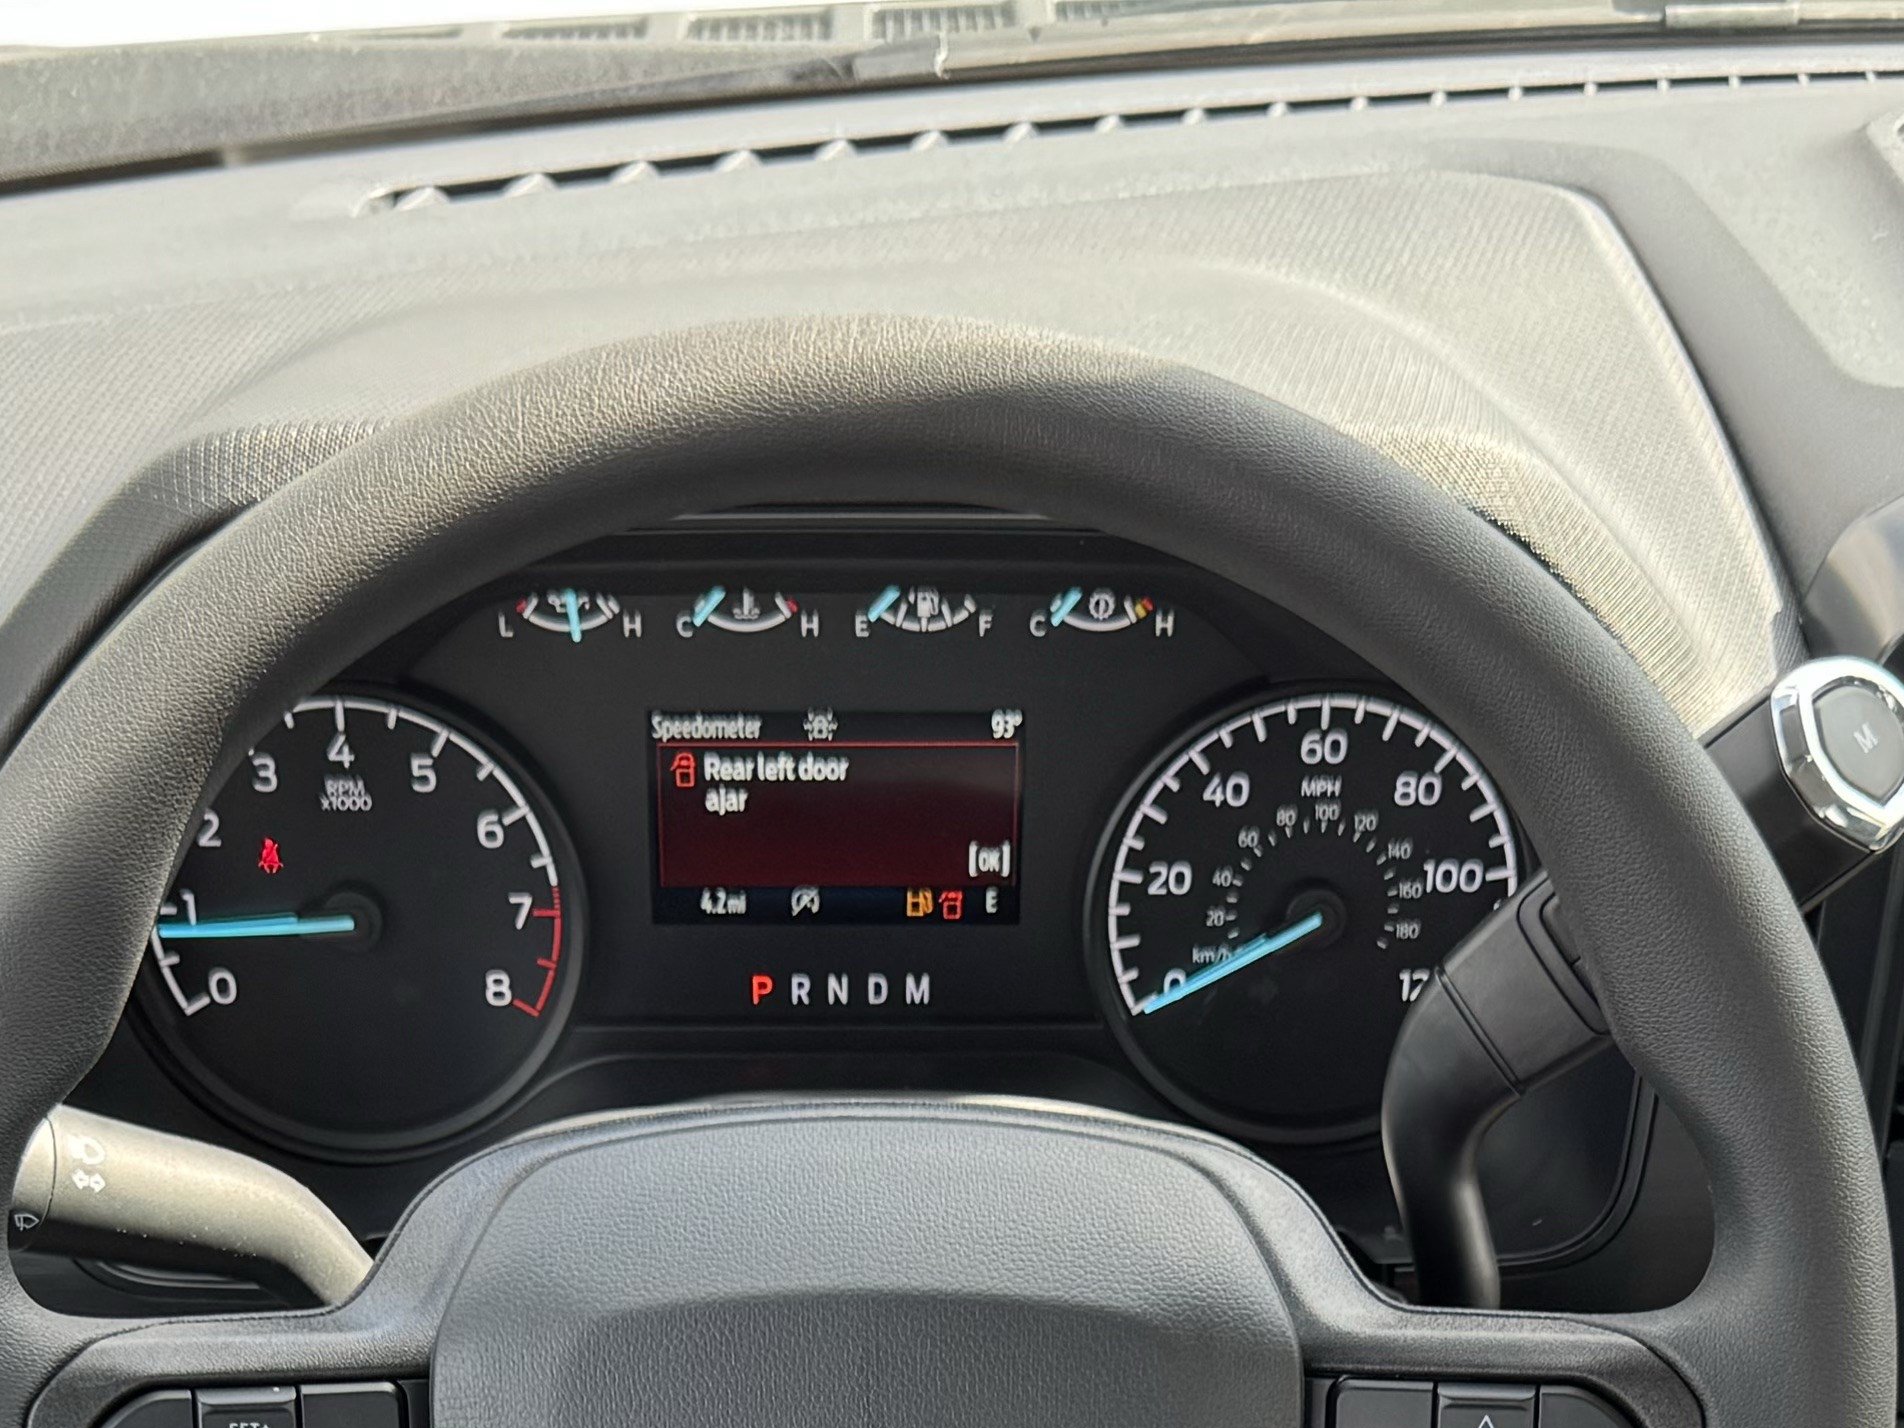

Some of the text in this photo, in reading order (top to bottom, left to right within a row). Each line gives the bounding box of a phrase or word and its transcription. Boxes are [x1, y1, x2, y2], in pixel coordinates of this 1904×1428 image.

[499, 611, 514, 638] L
[622, 611, 642, 638] H
[676, 611, 693, 638] C
[800, 611, 820, 638] H
[854, 611, 870, 638] E
[979, 611, 993, 638] F
[1029, 611, 1046, 638] C
[1155, 611, 1175, 638] H
[651, 710, 762, 742] Speedometer
[1853, 722, 1879, 754] M
[327, 731, 355, 768] 4
[1300, 729, 1349, 764] 60
[251, 756, 278, 793] 3
[410, 754, 437, 793] 5
[704, 751, 849, 782] Rear left door
[323, 775, 365, 798] RPM
[705, 783, 748, 815] ajar
[1202, 772, 1250, 808] 40
[1301, 775, 1343, 798] MPH
[1394, 771, 1443, 806] 80
[198, 809, 222, 847] 2
[1276, 805, 1296, 827] 80
[1315, 804, 1341, 822] 100
[1354, 813, 1379, 833] 120
[477, 811, 504, 849] 6
[1238, 826, 1260, 848] 60
[1148, 861, 1192, 895] 20
[1212, 868, 1232, 887] 40
[1423, 859, 1484, 894] 100
[180, 889, 196, 925] 1
[509, 892, 533, 930] 7
[208, 968, 237, 1005] 0
[485, 969, 513, 1007] 8
[752, 973, 930, 1006] P R N D M
[1399, 969, 1431, 1002] 12
